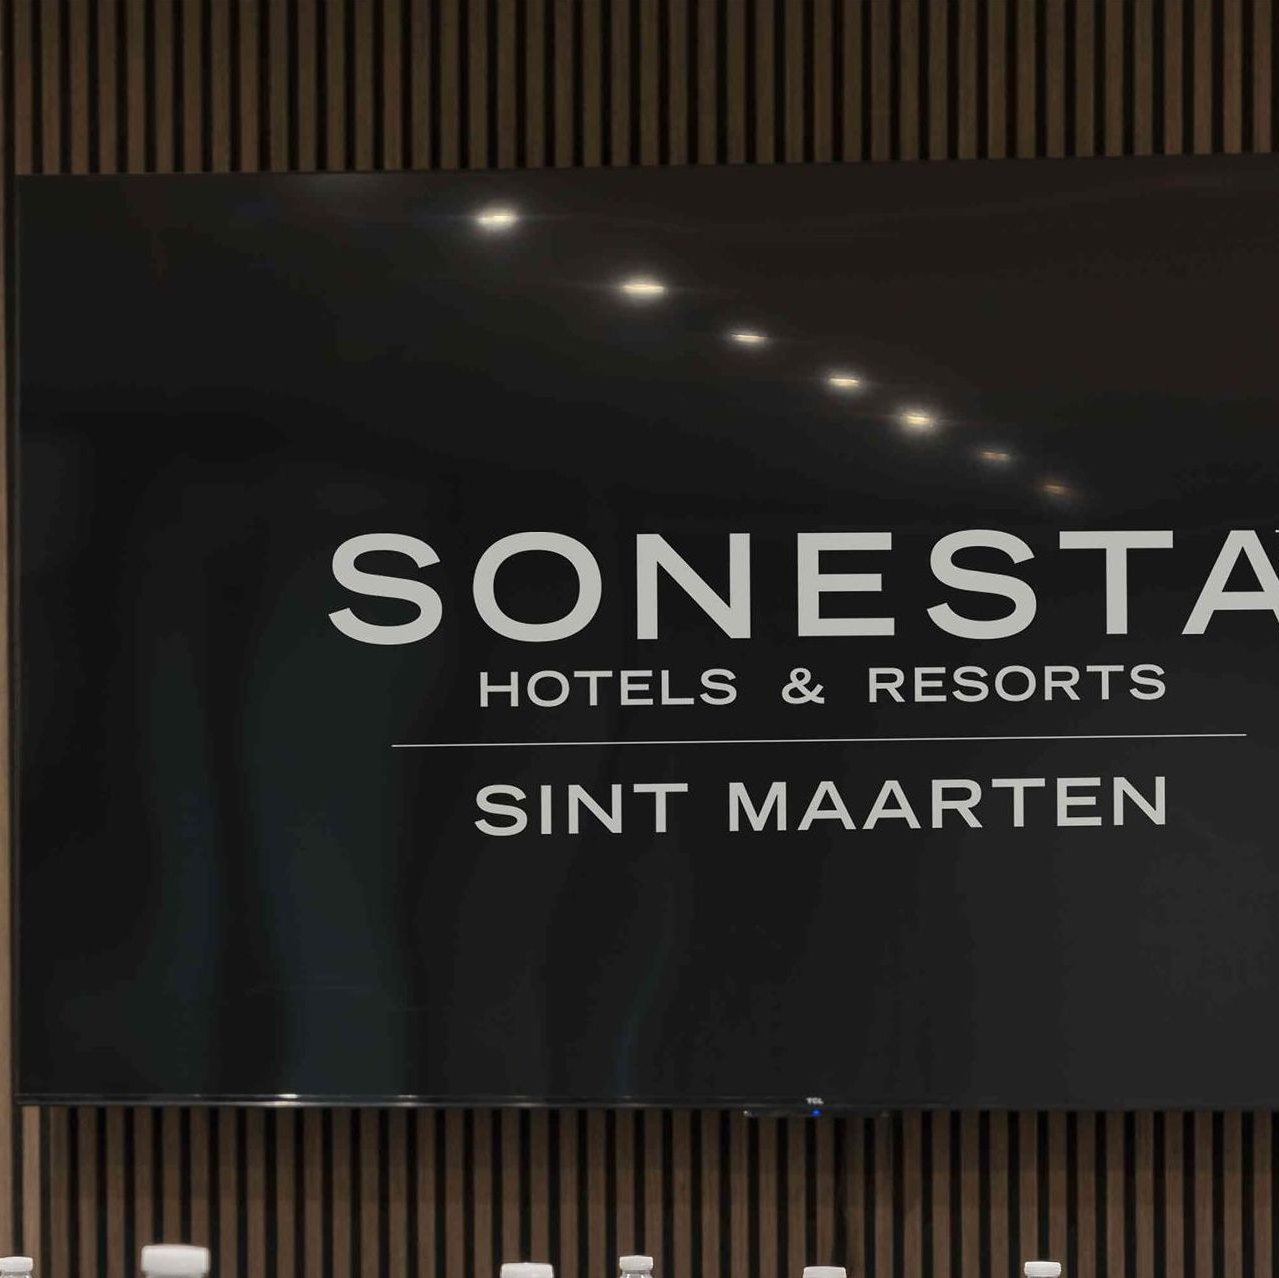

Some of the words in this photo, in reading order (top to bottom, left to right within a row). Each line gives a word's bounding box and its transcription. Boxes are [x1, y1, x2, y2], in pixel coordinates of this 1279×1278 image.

[479, 668, 737, 708] HOTELS
[781, 667, 825, 705] &
[868, 663, 1166, 703] RESORTS
[474, 782, 689, 837] SINT
[728, 775, 1166, 832] MAARTEN
